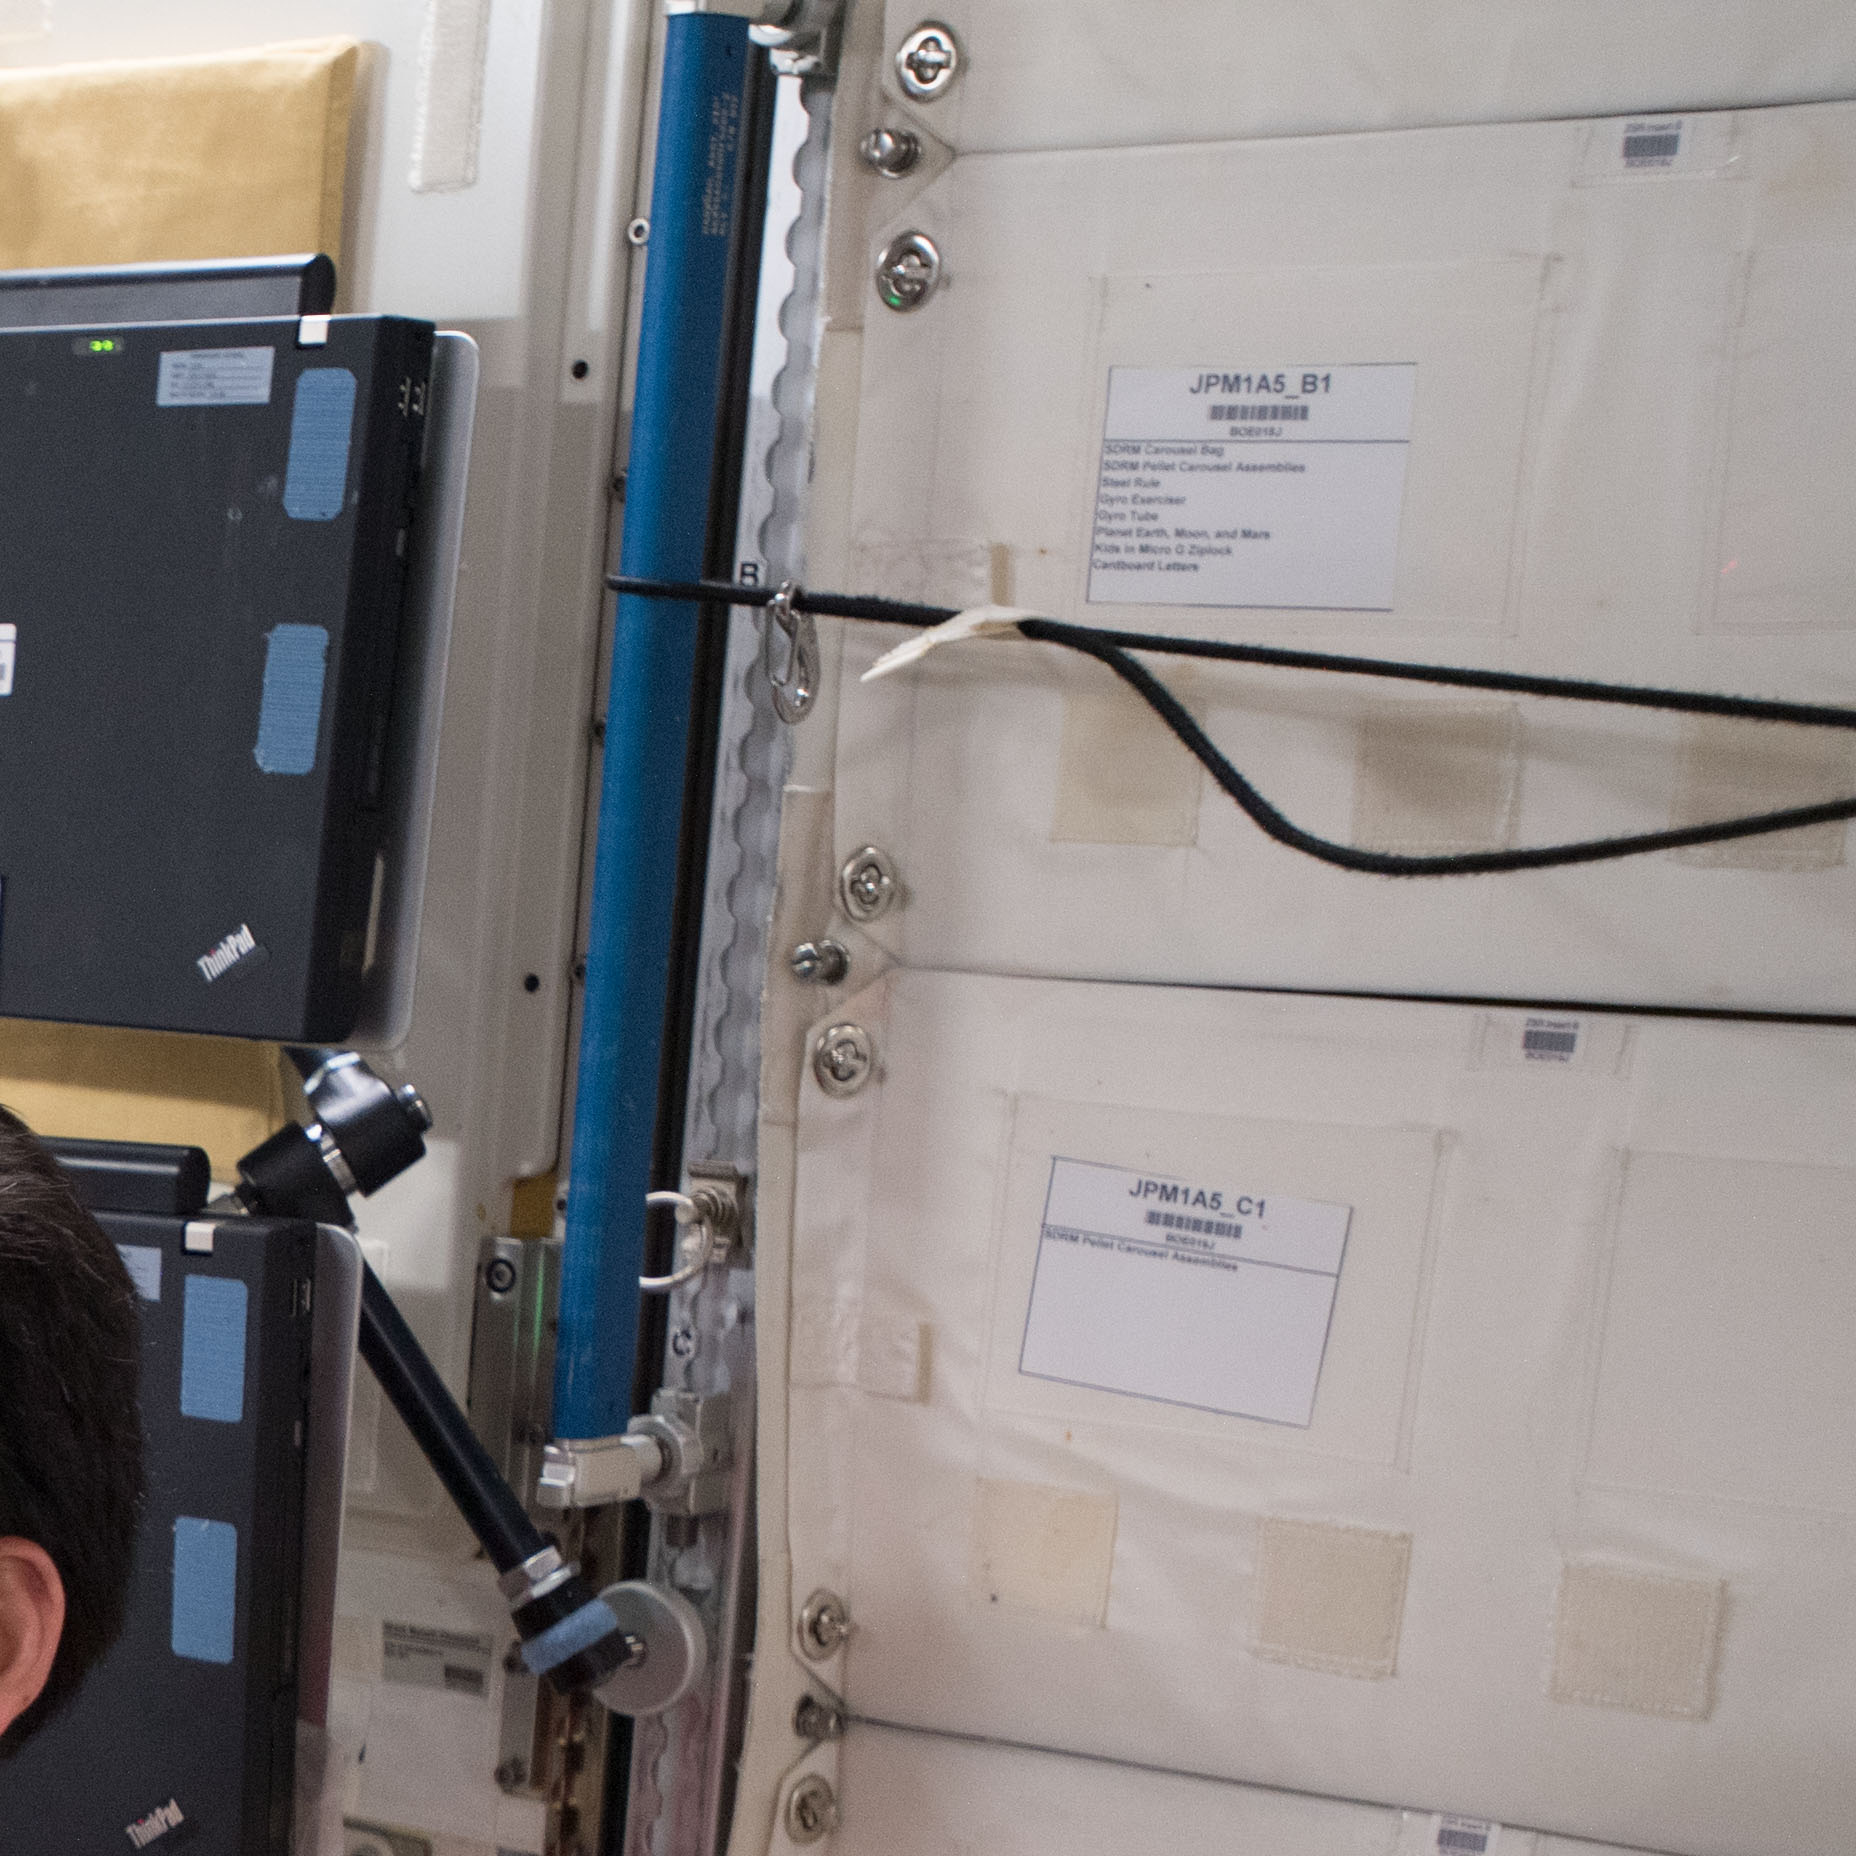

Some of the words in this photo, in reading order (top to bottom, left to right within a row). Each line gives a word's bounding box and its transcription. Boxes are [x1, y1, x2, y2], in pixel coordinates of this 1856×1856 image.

[1189, 373, 1333, 400] JPM1A5_B1
[1145, 445, 1197, 455] Carousel
[1200, 446, 1225, 457] Bag
[1103, 461, 1140, 471] SDRM
[1143, 462, 1176, 471] Pellet
[1179, 462, 1232, 472] Carousel
[1236, 462, 1306, 473] Assemblies
[1102, 478, 1131, 487] Steel
[1134, 478, 1160, 488] Rule
[1131, 511, 1159, 521] Tube
[1095, 527, 1132, 537] Planet
[1214, 529, 1237, 539] and
[1240, 529, 1271, 540] Mars
[1124, 544, 1135, 553] in
[1139, 544, 1171, 554] Micro
[1188, 545, 1232, 557] Ziplock
[1093, 559, 1155, 570] Cardboard
[1158, 560, 1199, 572] Letters
[197, 924, 256, 982] ThinkPad
[1128, 1178, 1266, 1219] JPM1A5_C1
[1117, 1241, 1169, 1260] Carousel
[1172, 1250, 1238, 1272] Assemblies
[126, 1798, 184, 1849] ThinkPad
